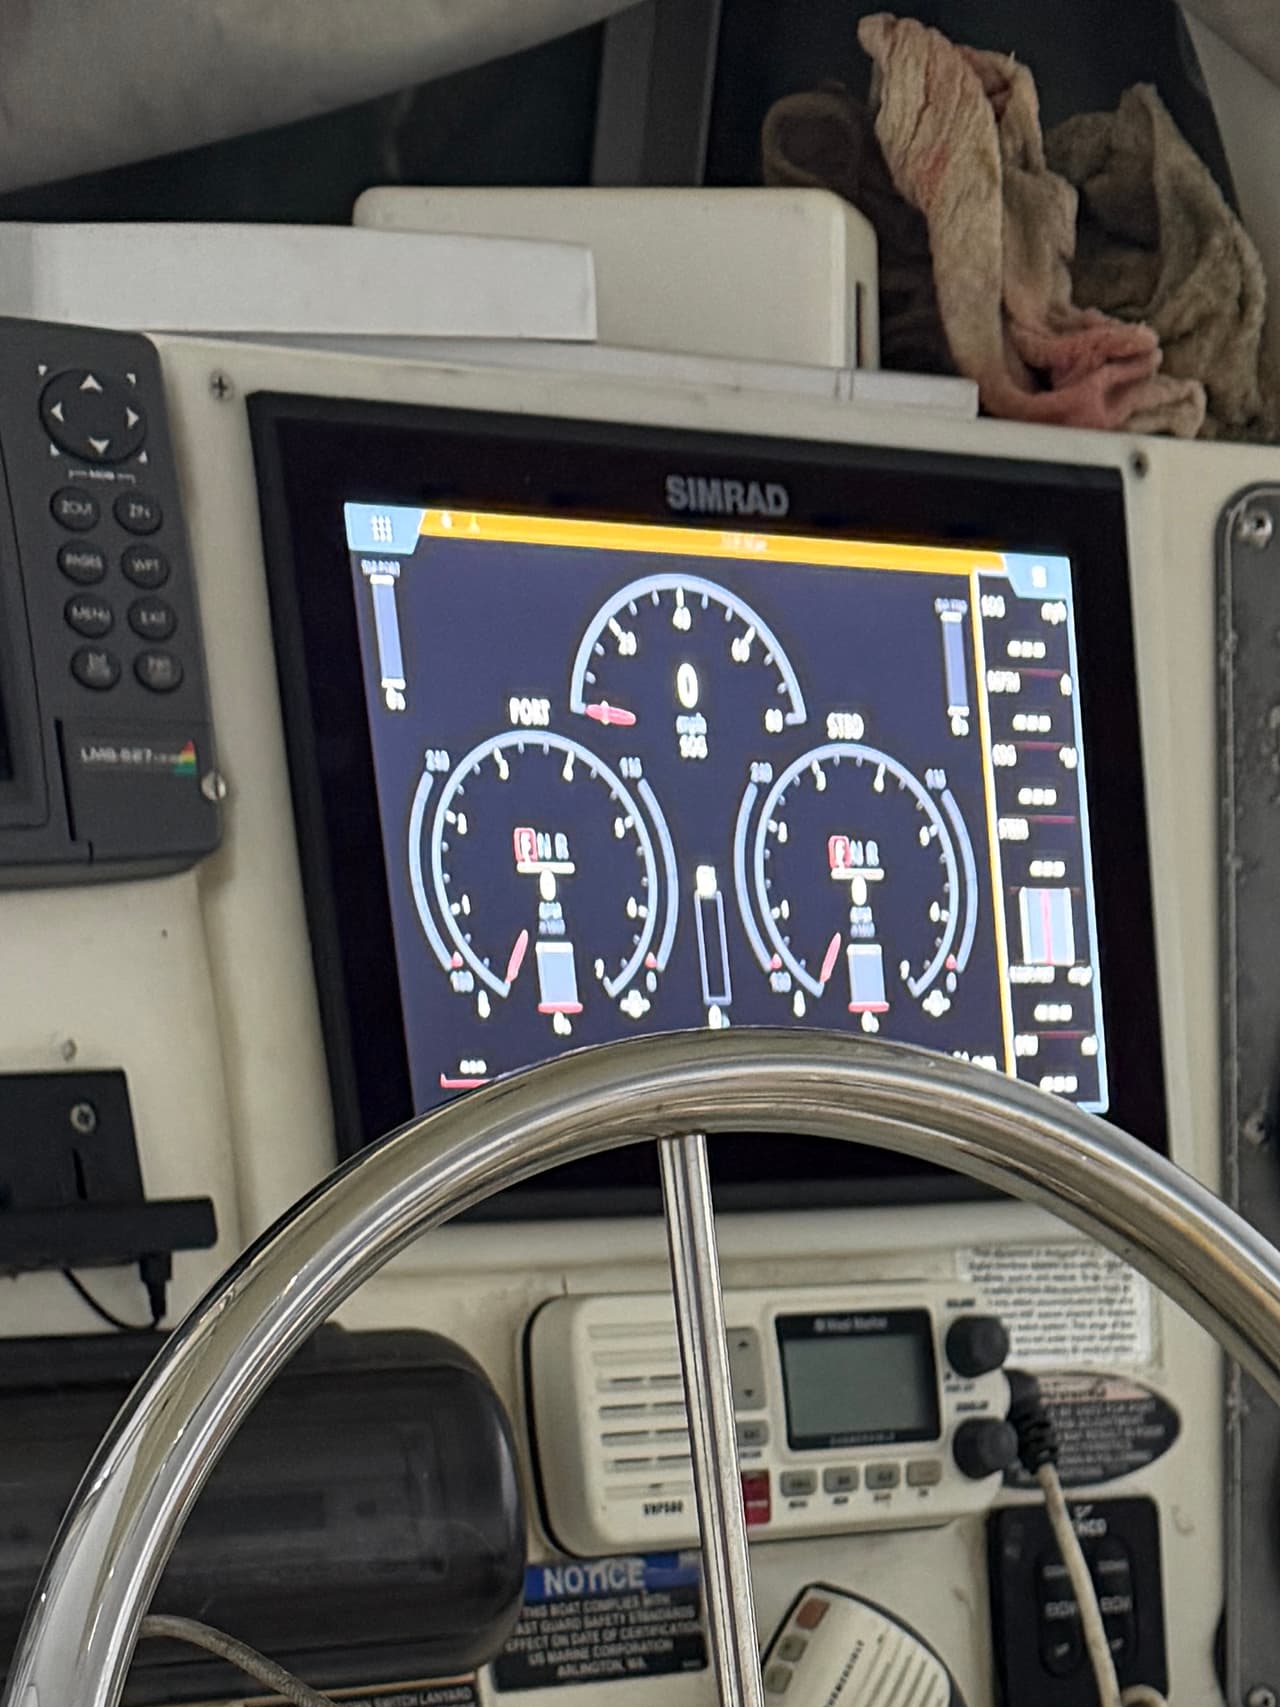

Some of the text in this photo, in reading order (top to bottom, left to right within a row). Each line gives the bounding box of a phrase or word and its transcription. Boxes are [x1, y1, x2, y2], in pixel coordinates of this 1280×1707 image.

[665, 474, 790, 517] SIMRAD
[675, 662, 700, 709] 0
[509, 696, 551, 727] PORT
[542, 1558, 647, 1597] NOTICE
[584, 1611, 626, 1629] SAFETY
